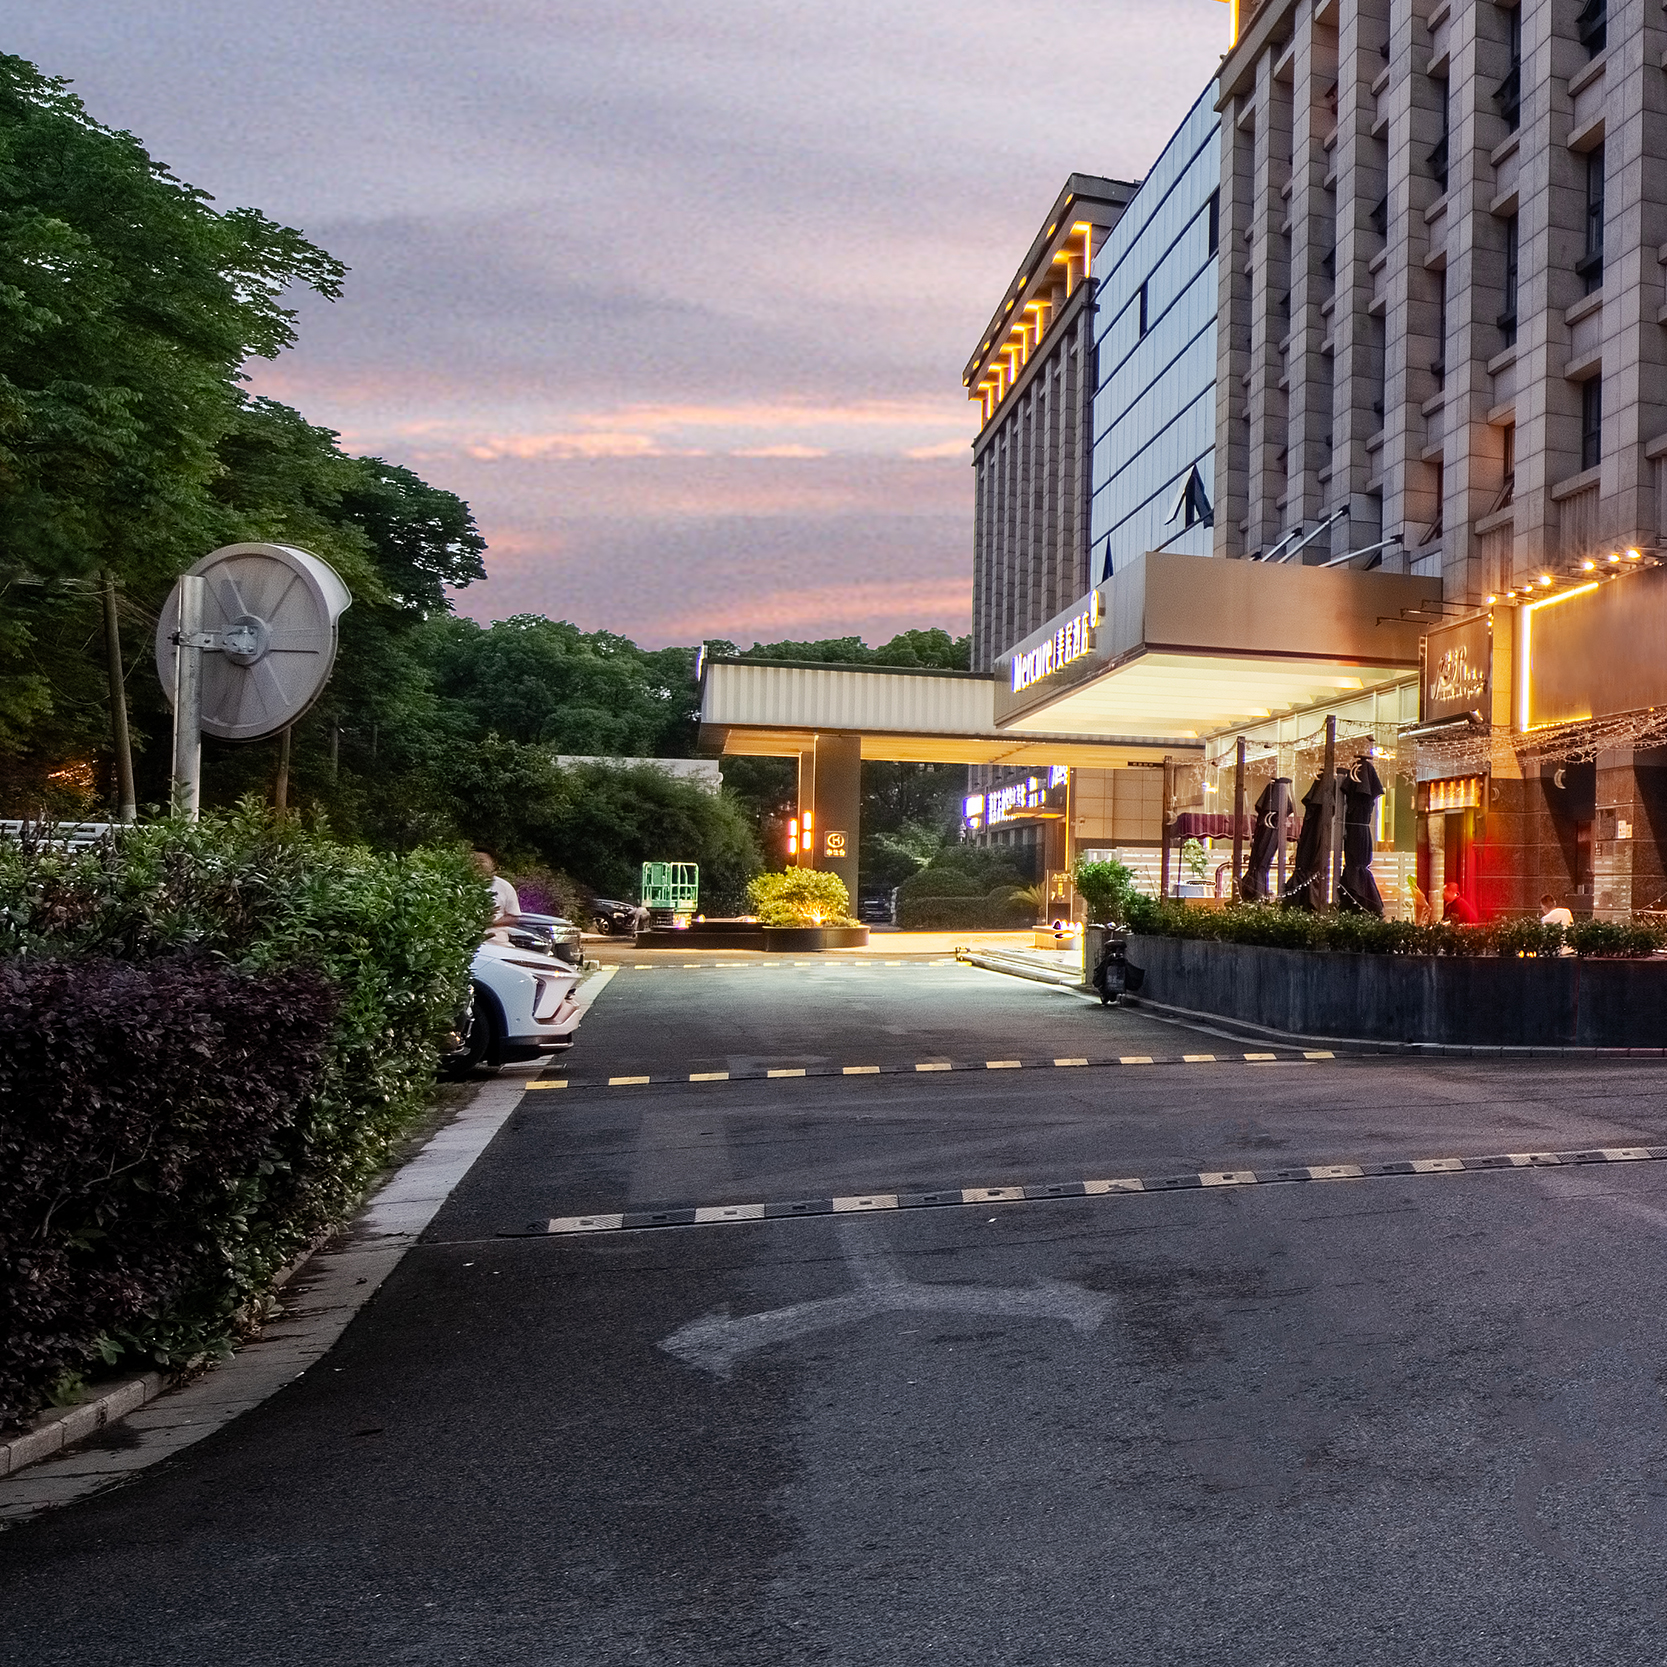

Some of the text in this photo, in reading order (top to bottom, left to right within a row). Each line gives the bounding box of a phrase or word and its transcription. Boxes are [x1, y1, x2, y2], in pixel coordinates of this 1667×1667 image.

[1012, 638, 1053, 693] Mercure
[1056, 611, 1089, 670] 美居酒店
